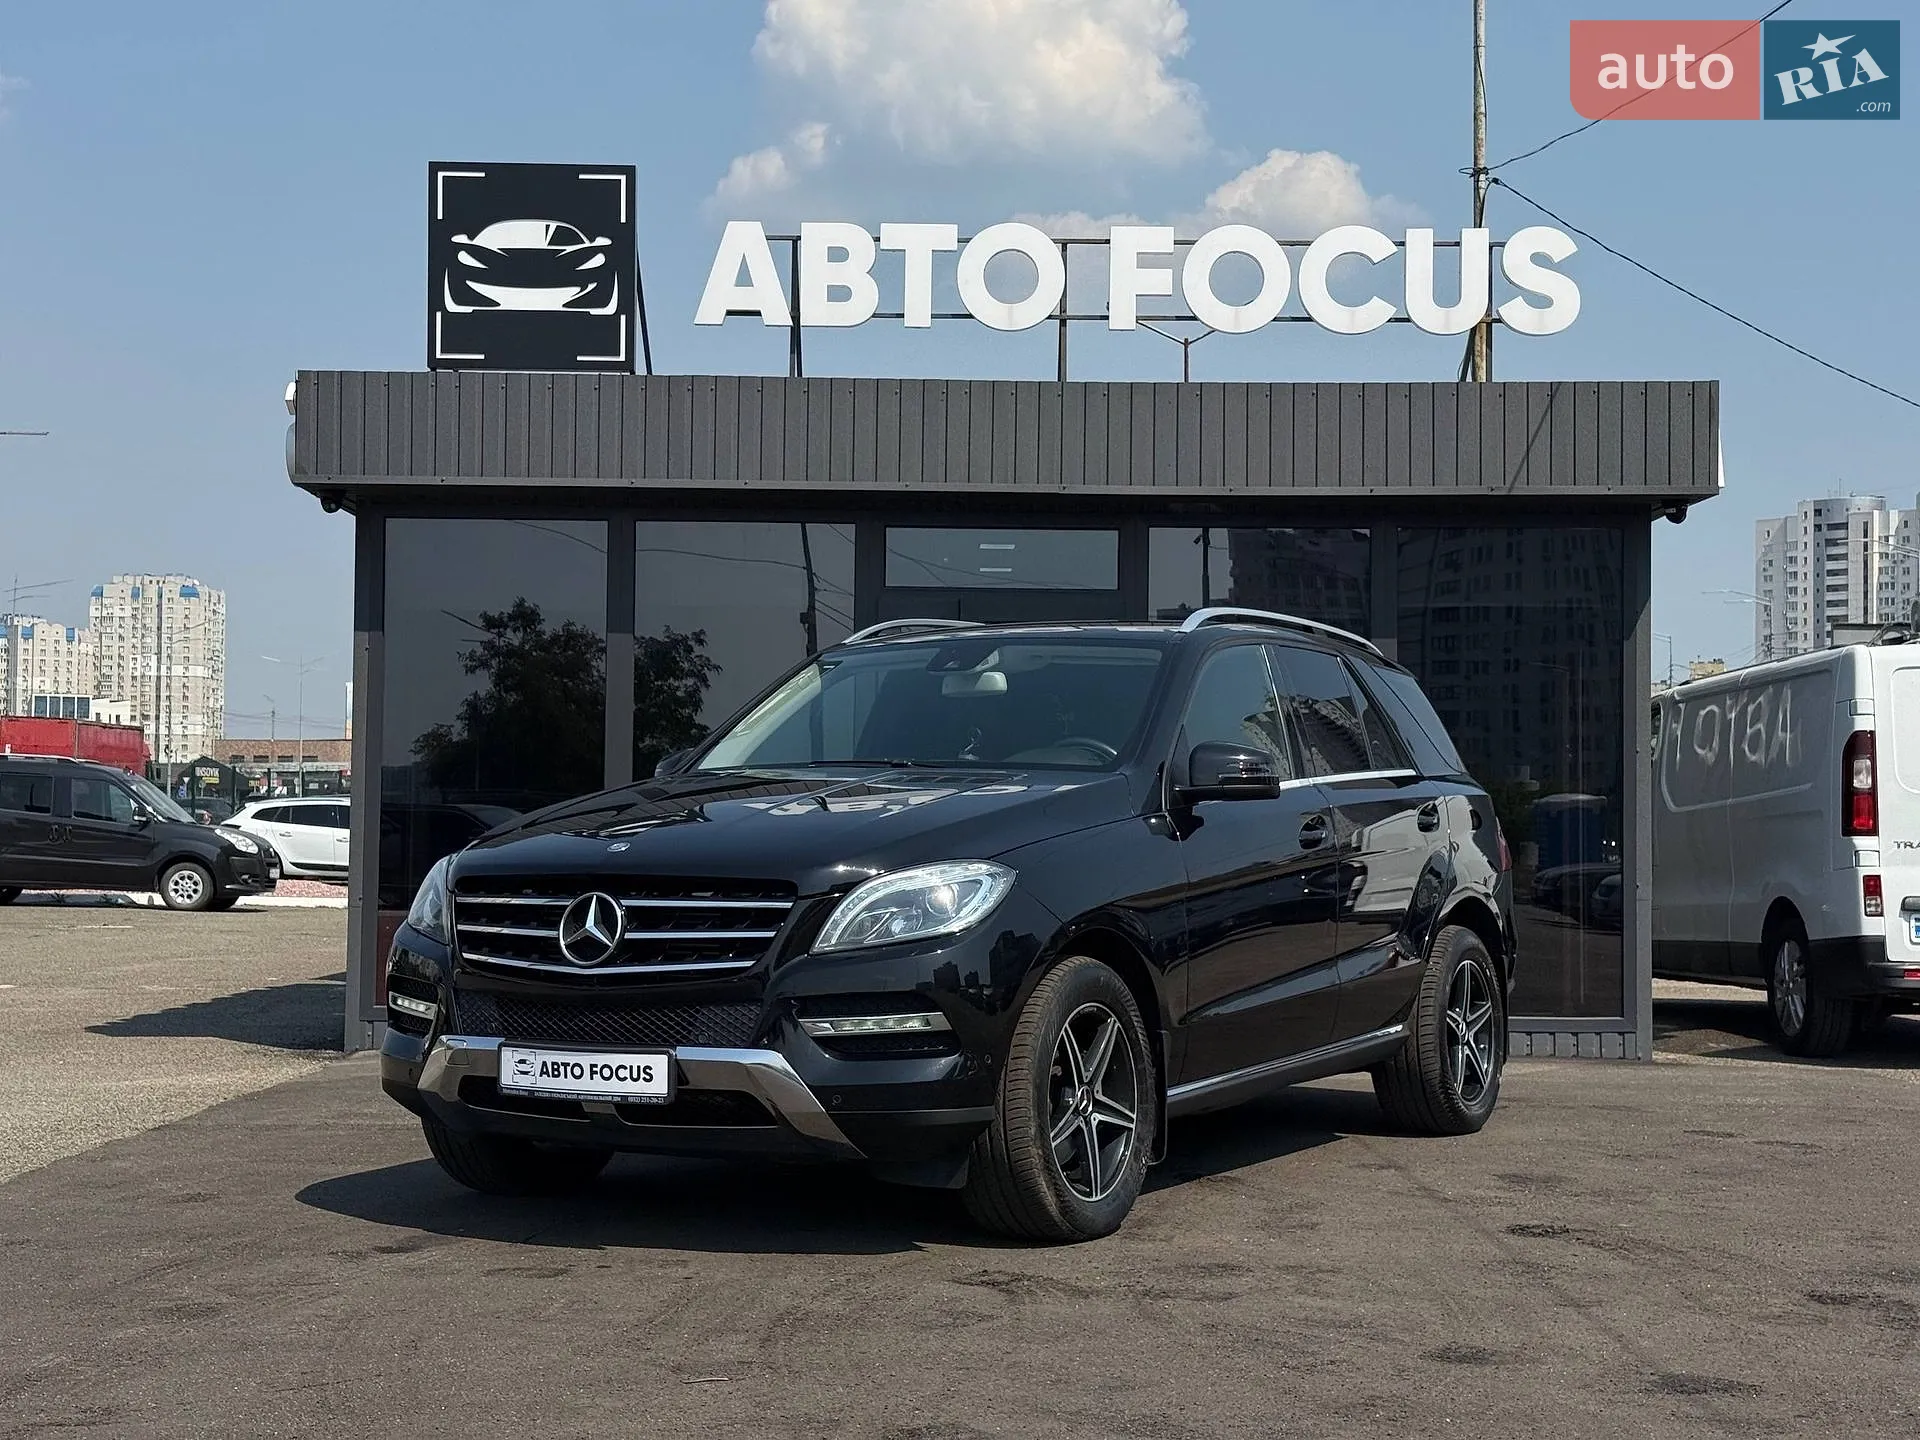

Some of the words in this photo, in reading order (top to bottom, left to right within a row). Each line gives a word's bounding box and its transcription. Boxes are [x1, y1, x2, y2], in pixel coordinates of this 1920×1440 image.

[694, 220, 1066, 332] АВТО
[1109, 224, 1582, 336] FOCUS
[539, 1060, 585, 1080] АВТО
[589, 1063, 654, 1083] FOCUS
